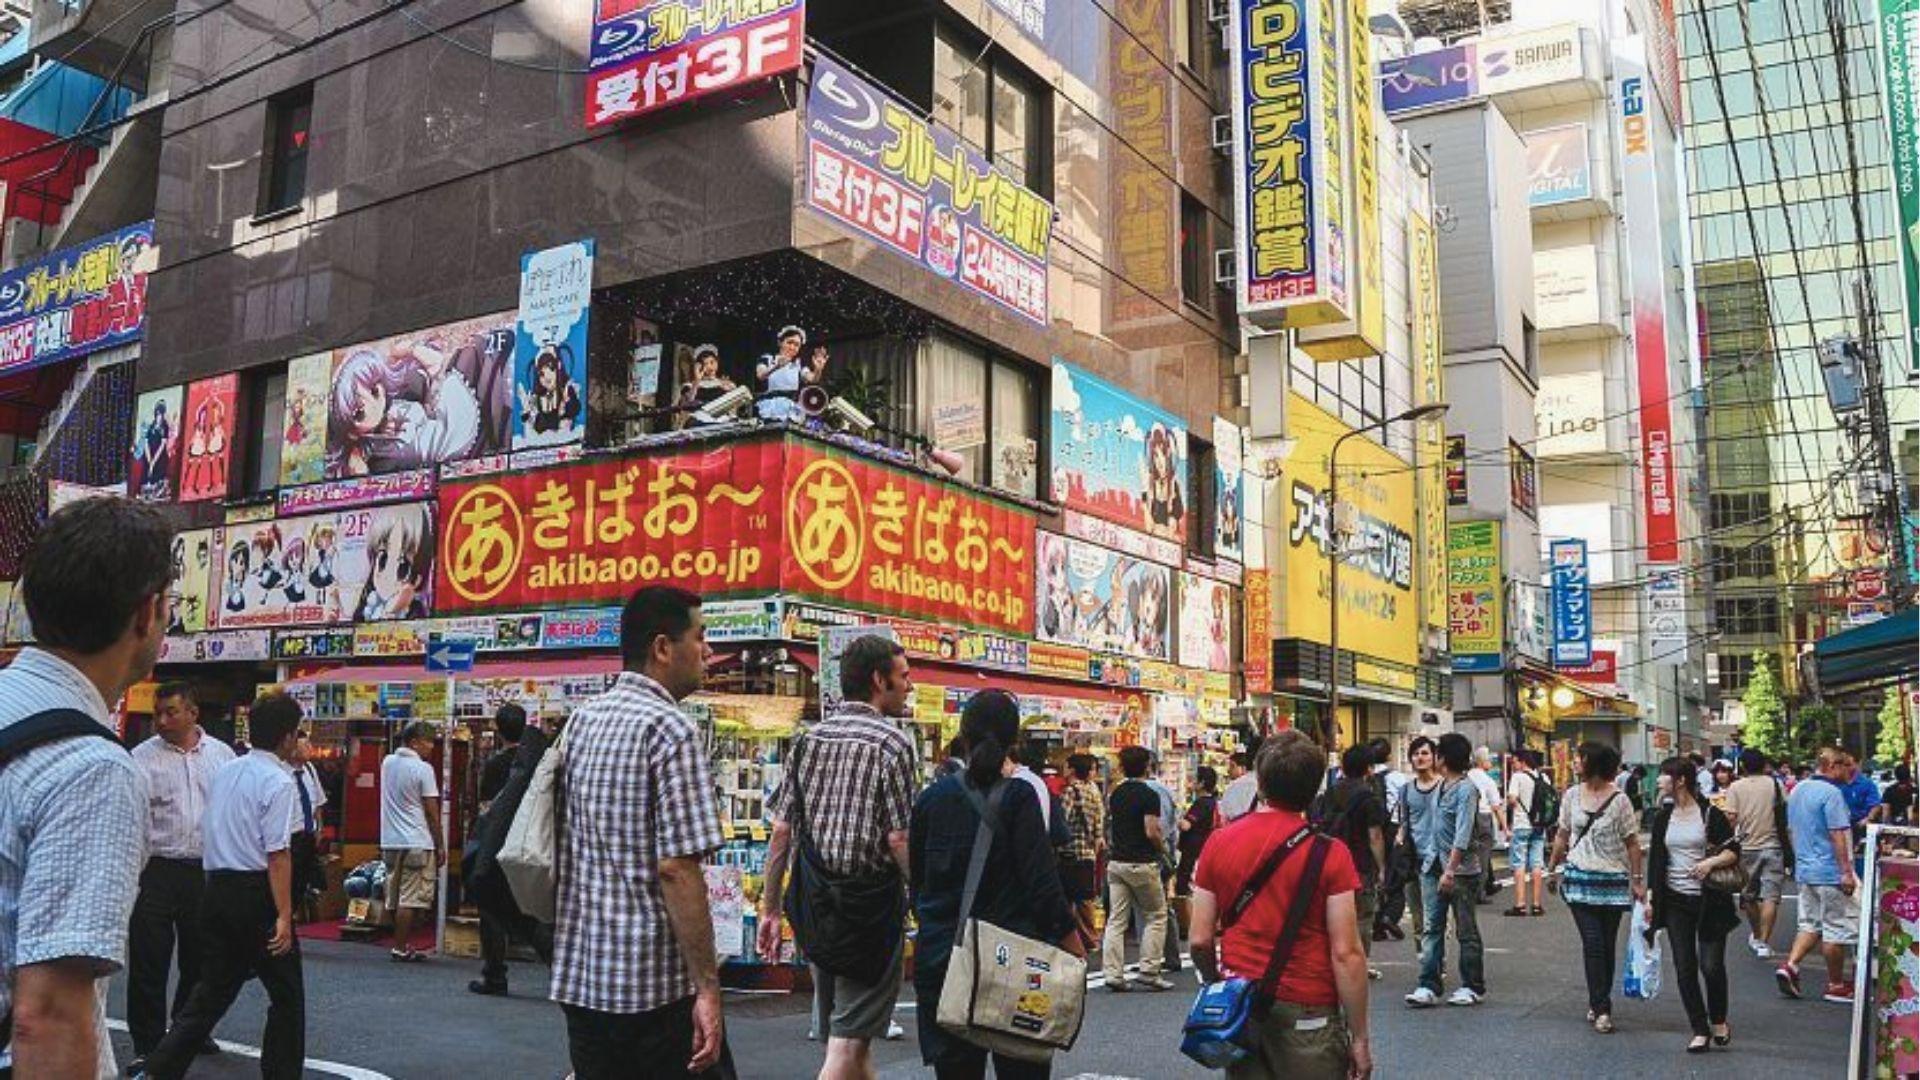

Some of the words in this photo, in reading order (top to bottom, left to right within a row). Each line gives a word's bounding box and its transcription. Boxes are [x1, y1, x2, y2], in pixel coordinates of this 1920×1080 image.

[595, 18, 791, 122] 受付3F
[1514, 39, 1573, 66] SANWA
[813, 150, 922, 248] 受付3F
[484, 331, 507, 356] 2F
[344, 512, 371, 538] 2F
[455, 498, 514, 584] あ
[748, 514, 767, 530] TM
[800, 471, 857, 574] あ
[527, 539, 761, 588] akibaoo.co.jp
[868, 560, 1025, 625] akibaoo.co.jp
